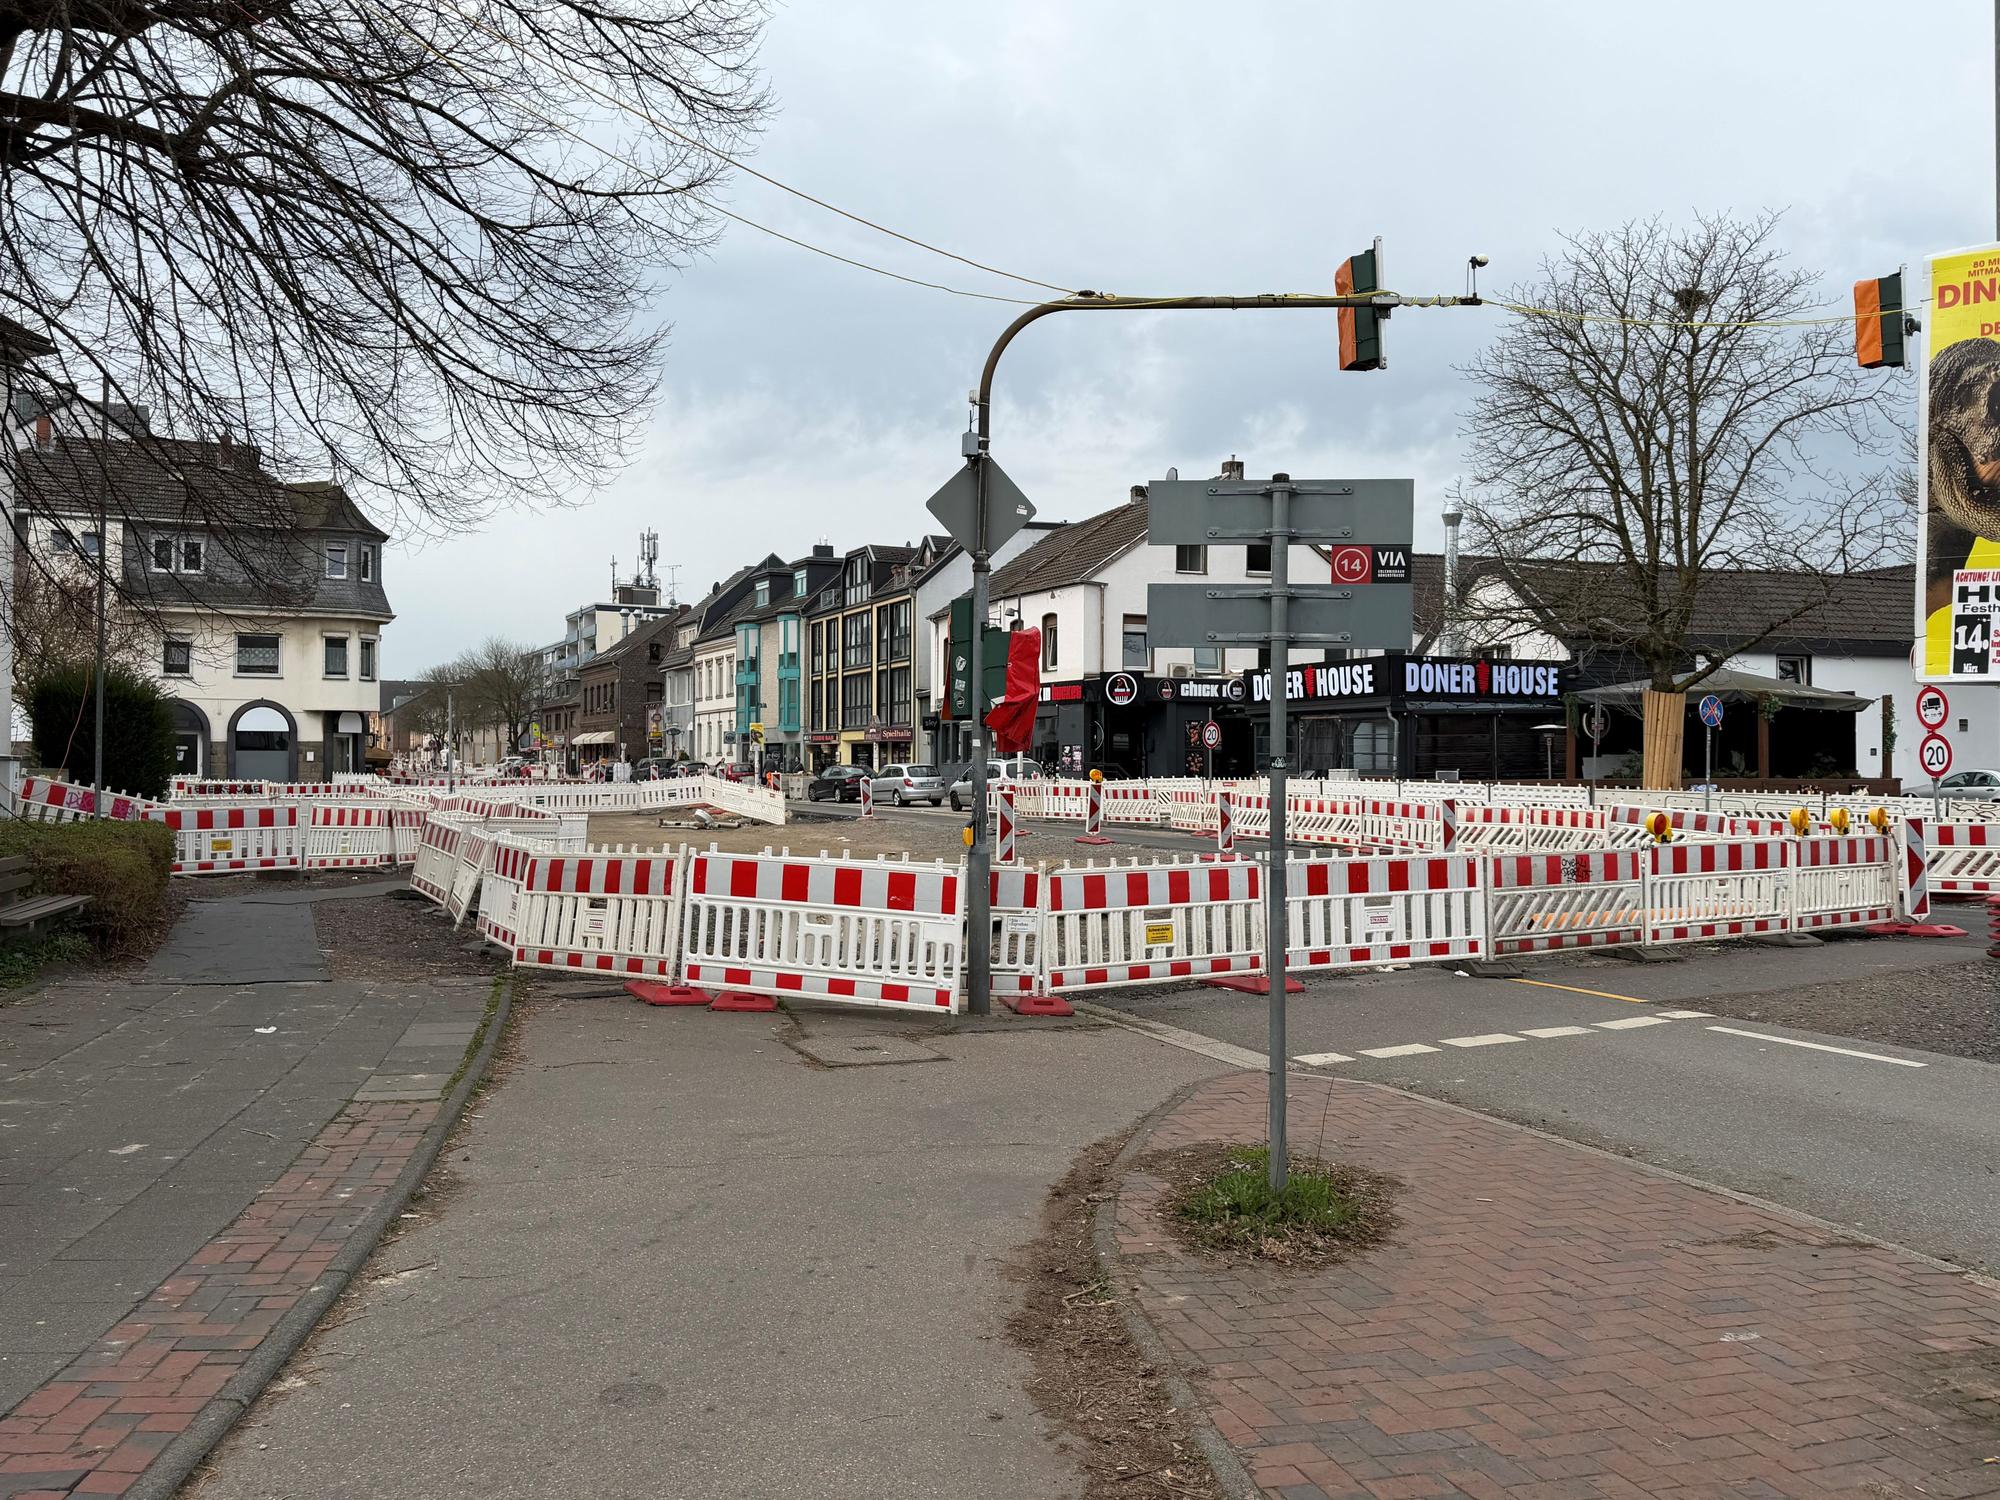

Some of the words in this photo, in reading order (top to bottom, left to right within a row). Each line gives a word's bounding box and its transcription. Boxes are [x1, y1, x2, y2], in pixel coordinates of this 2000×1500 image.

[1973, 260, 1985, 268] 80
[1938, 278, 2000, 309] DIN
[1341, 558, 1361, 571] 14
[1378, 551, 1406, 566] VIA
[1955, 571, 1990, 583] ACHTUNG!
[1955, 623, 1989, 653] 14.
[1252, 668, 1304, 701] DÖER
[1316, 663, 1374, 697] HOUSE
[1405, 656, 1476, 694] DÖNER
[1492, 665, 1558, 696] HOUSE
[882, 729, 912, 739] Spielhalle
[1206, 728, 1217, 741] 20
[1926, 745, 1945, 766] 20
